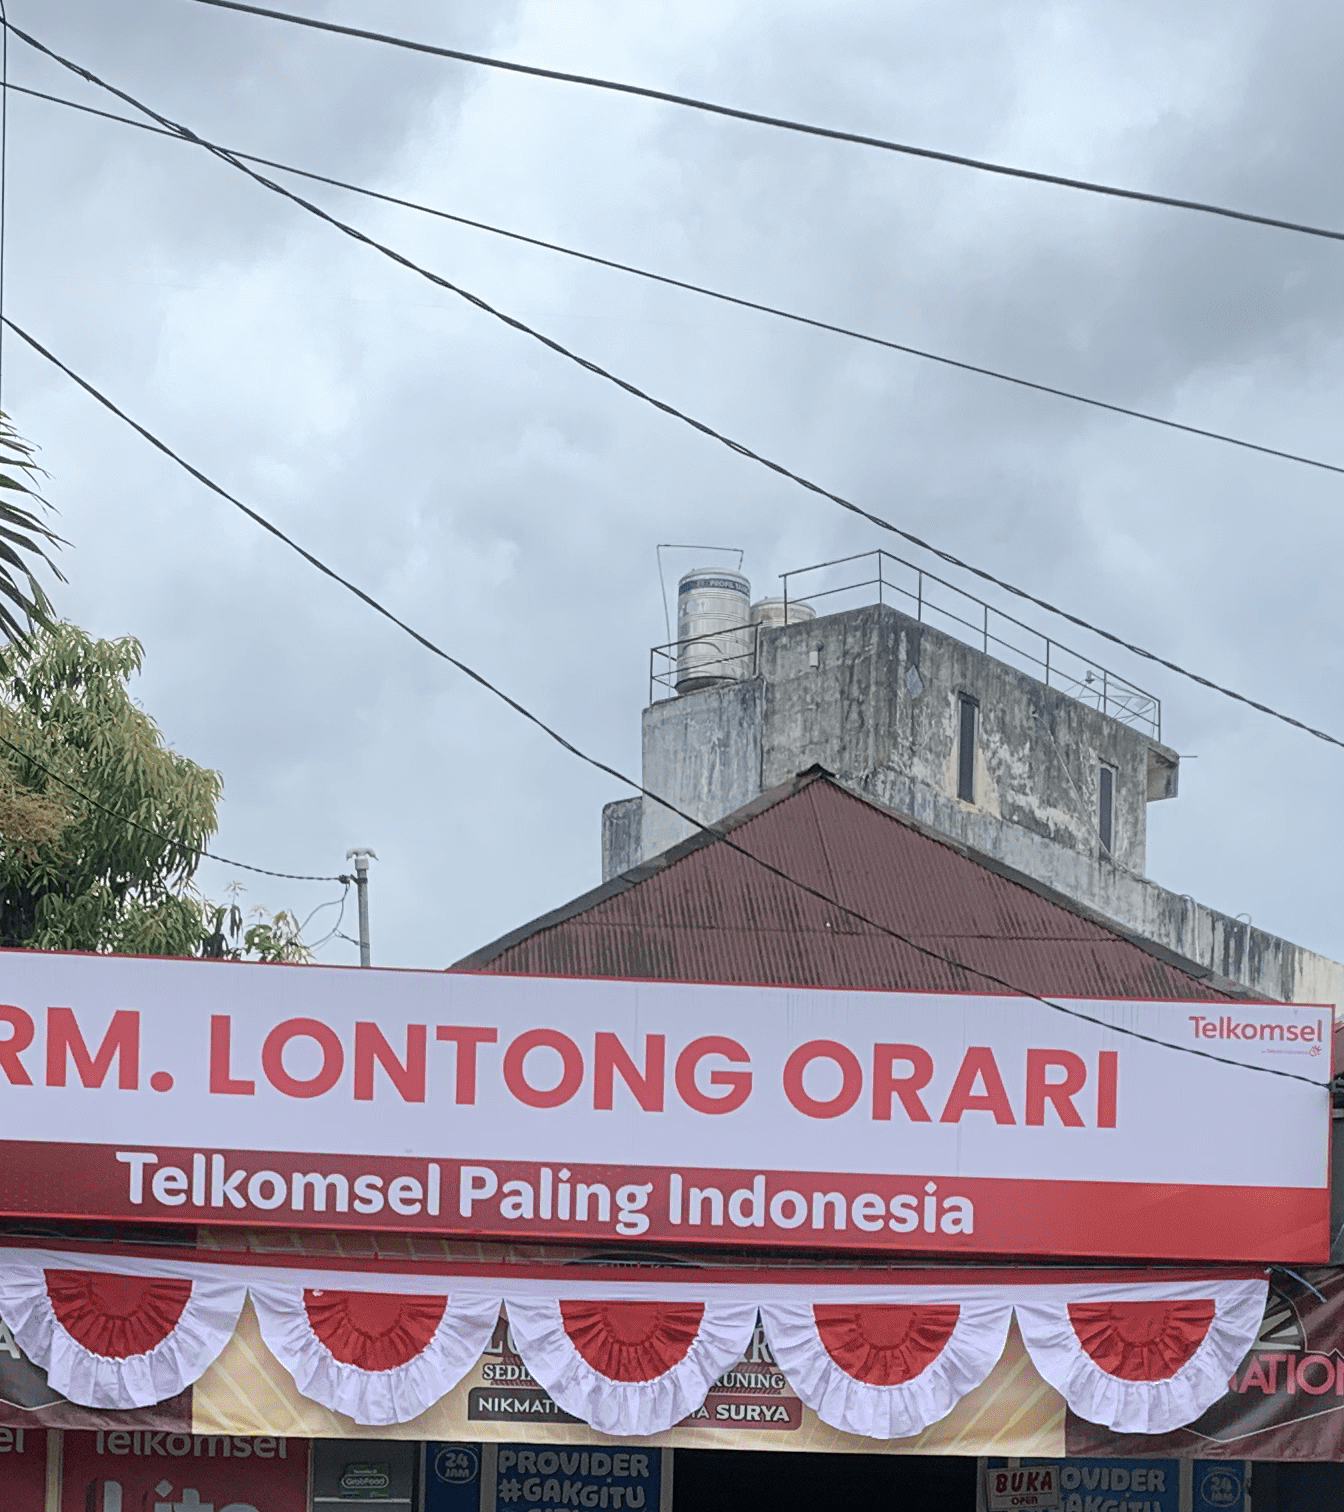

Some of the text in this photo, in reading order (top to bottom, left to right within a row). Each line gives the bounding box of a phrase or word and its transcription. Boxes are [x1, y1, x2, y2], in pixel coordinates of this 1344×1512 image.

[1187, 1014, 1323, 1043] Telkomsel
[209, 1014, 753, 1115] LONTONG
[782, 1034, 1119, 1129] ORARI
[115, 1151, 975, 1238] Telkomsel Paling Indonesia
[716, 1404, 790, 1422] SURYA
[498, 1450, 650, 1478] PROVIDER
[498, 1478, 646, 1509] #GAKGITU
[995, 1471, 1053, 1493] BUKA
[1059, 1467, 1166, 1493] OVIDER
